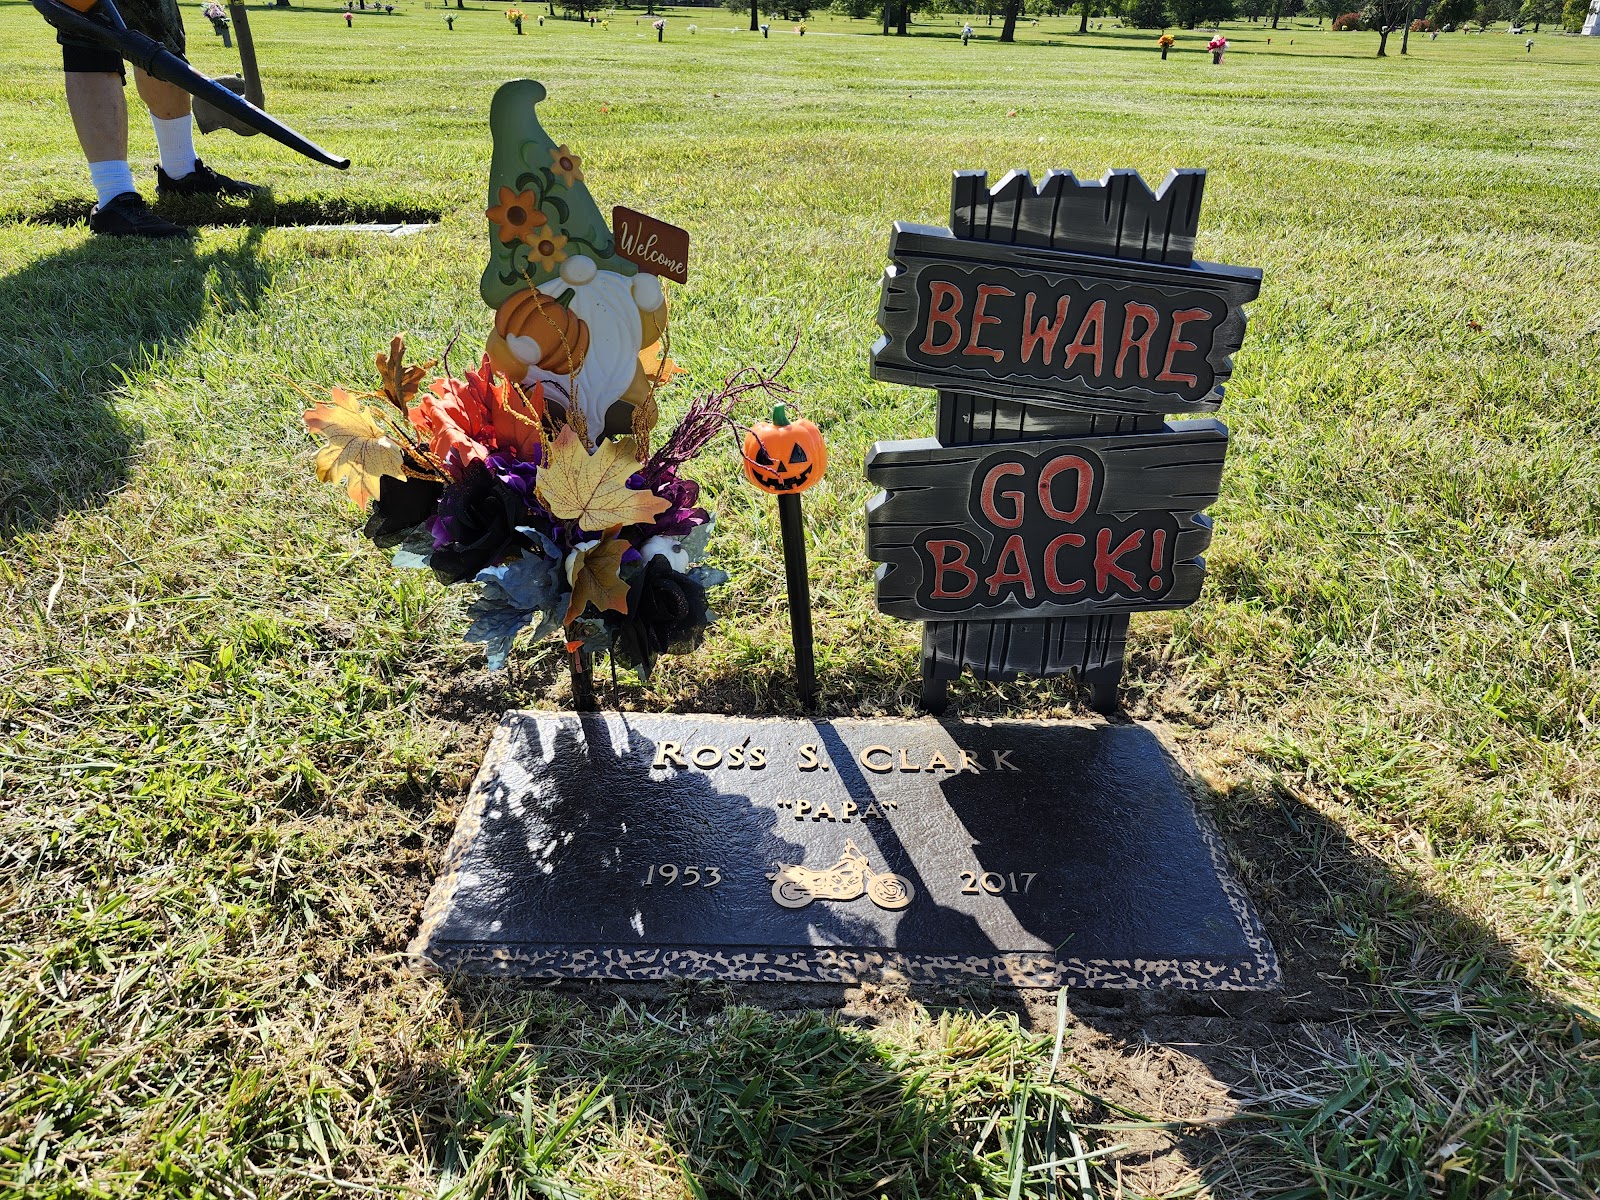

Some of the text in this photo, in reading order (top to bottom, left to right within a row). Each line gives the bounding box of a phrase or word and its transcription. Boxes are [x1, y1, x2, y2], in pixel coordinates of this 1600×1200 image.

[621, 221, 686, 274] Welcome
[918, 280, 1213, 389] BEWARE
[980, 454, 1095, 529] GO
[924, 527, 1167, 600] BACK!
[797, 743, 830, 772] S.
[642, 862, 723, 888] 1953
[960, 870, 1039, 896] 2017
